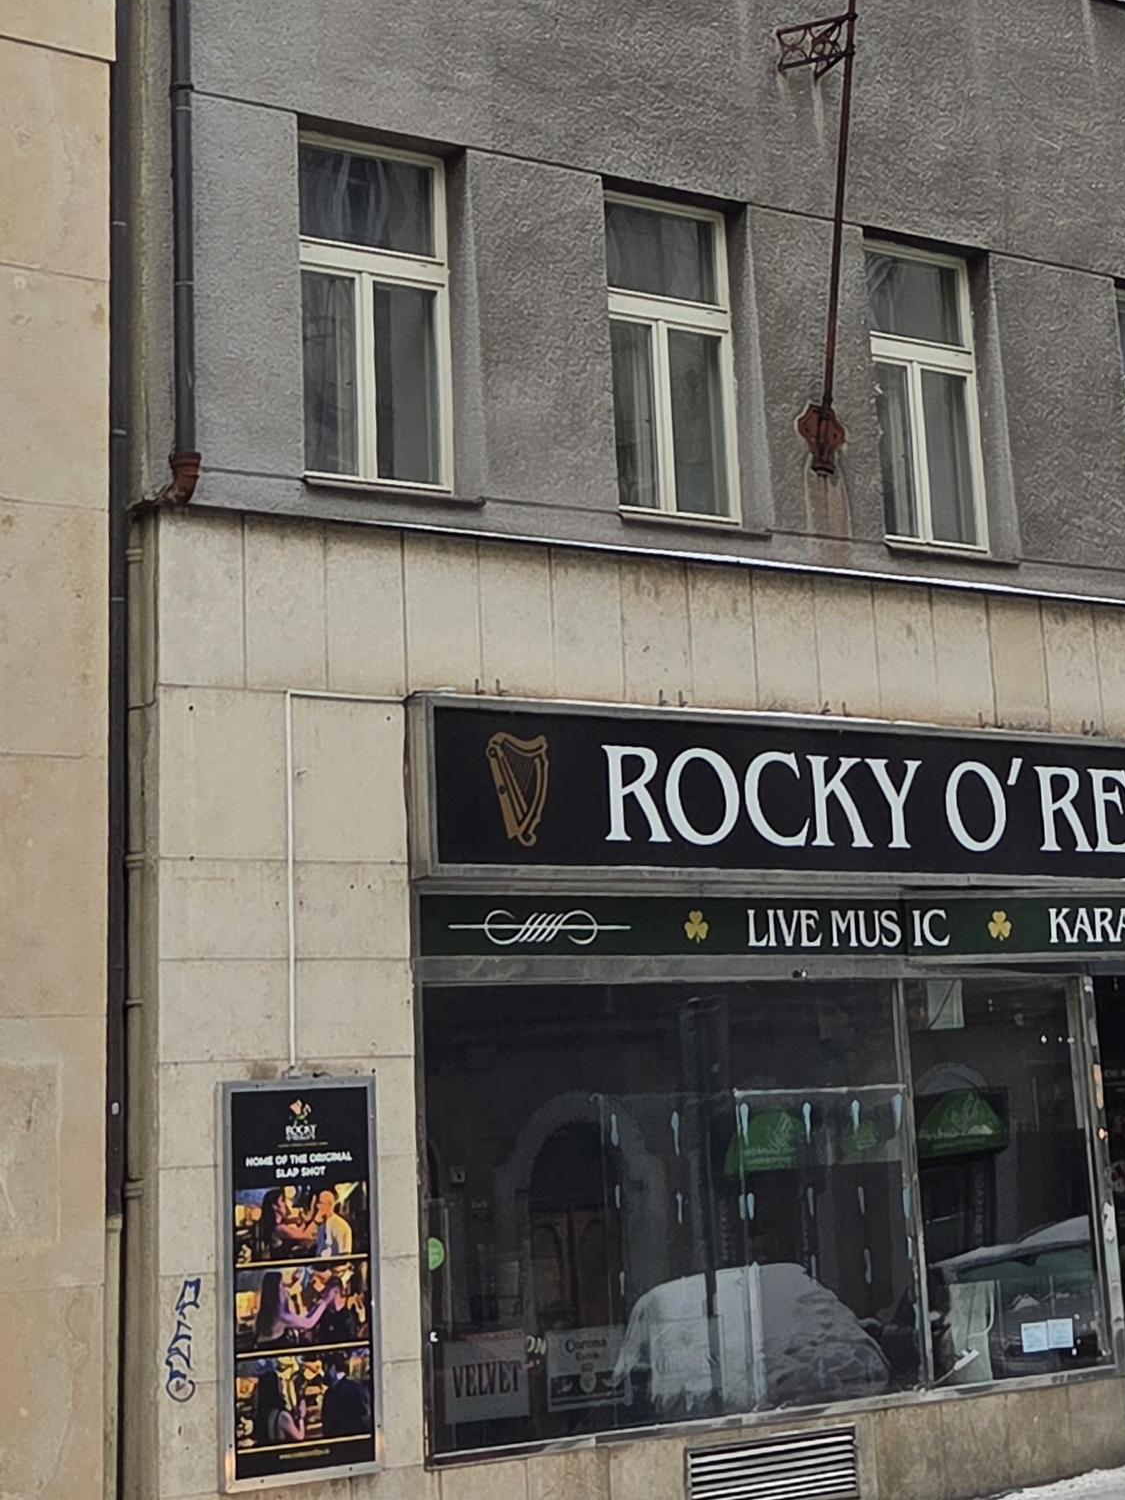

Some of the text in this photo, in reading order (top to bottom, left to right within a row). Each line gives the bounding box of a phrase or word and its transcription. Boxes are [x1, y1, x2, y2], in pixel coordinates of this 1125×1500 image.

[601, 744, 922, 849] ROCKY
[747, 909, 823, 947] LIVE
[289, 1153, 308, 1164] THE
[452, 1360, 523, 1398] VELVET
